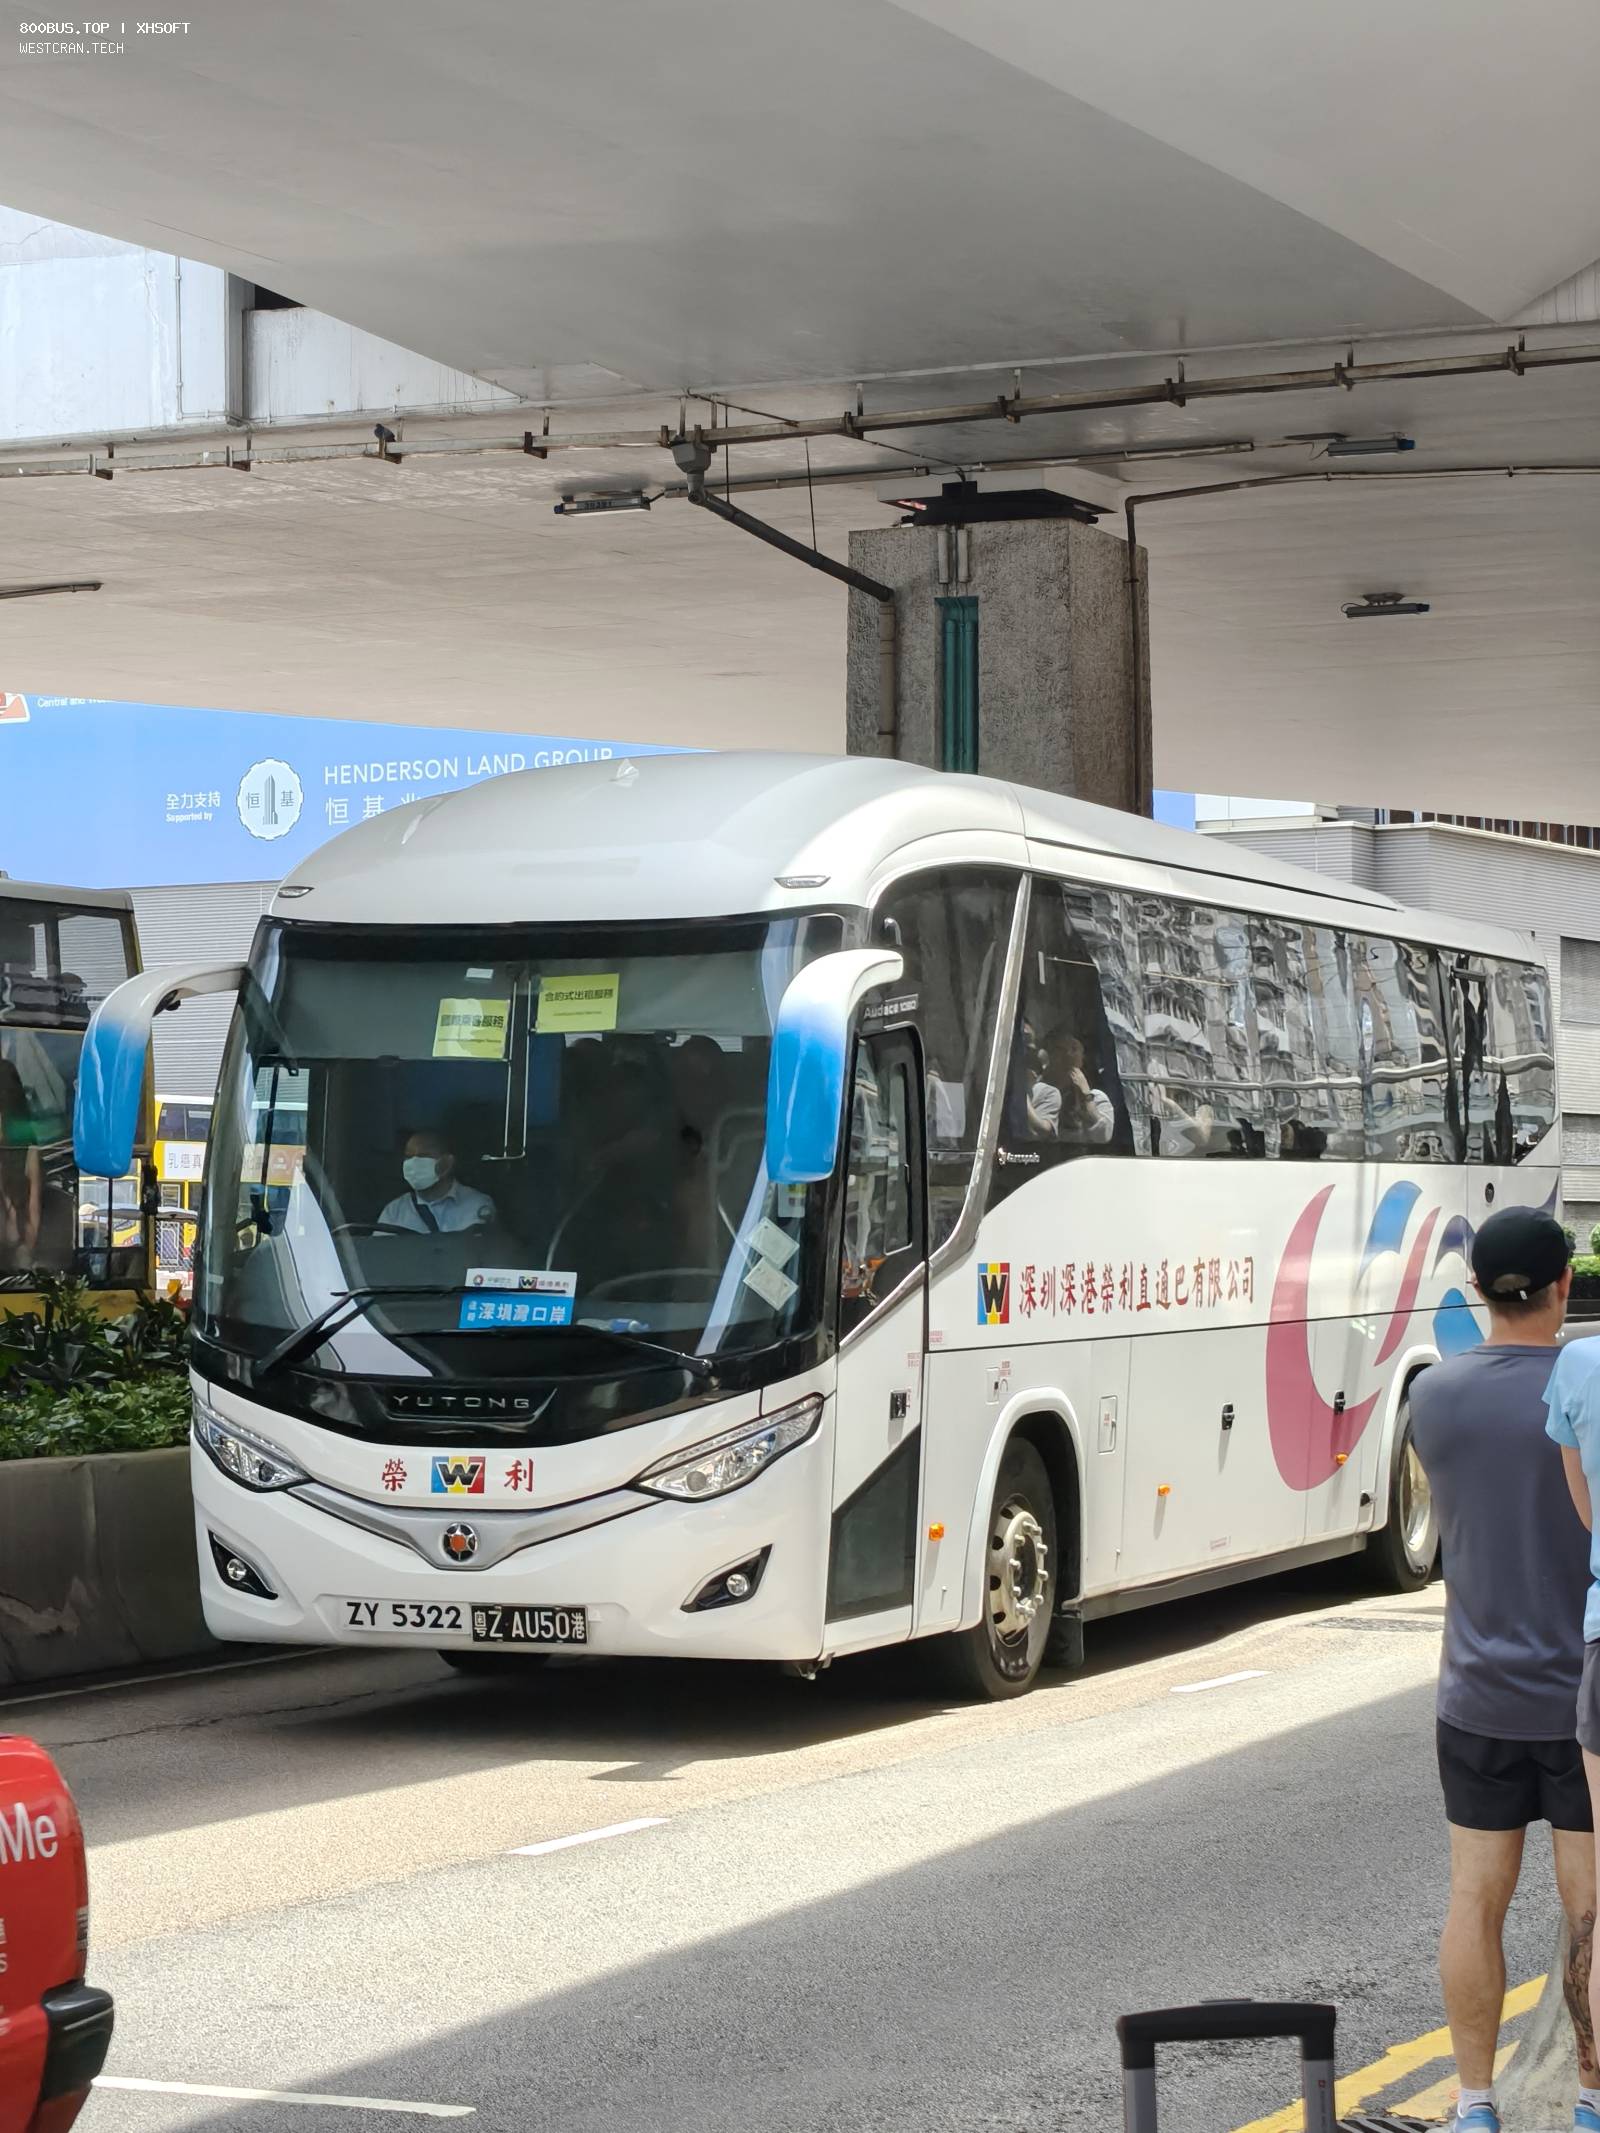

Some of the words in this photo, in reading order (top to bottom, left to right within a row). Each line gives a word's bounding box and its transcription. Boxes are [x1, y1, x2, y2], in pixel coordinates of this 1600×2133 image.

[37, 698, 67, 708] Central
[324, 756, 459, 785] HENDERSON
[467, 753, 526, 776] LAND
[534, 747, 613, 769] GROUP
[166, 791, 221, 811] 全力支持
[165, 812, 203, 823] Supported
[204, 811, 213, 822] by
[978, 1269, 1009, 1317] W
[1019, 1256, 1254, 1318] 深圳深港榮利直通巴有限公司
[393, 1395, 530, 1409] YUTONG
[381, 1458, 408, 1492] 榮
[503, 1458, 535, 1493] 利
[346, 1602, 379, 1626] ZY
[392, 1604, 463, 1630] 5322
